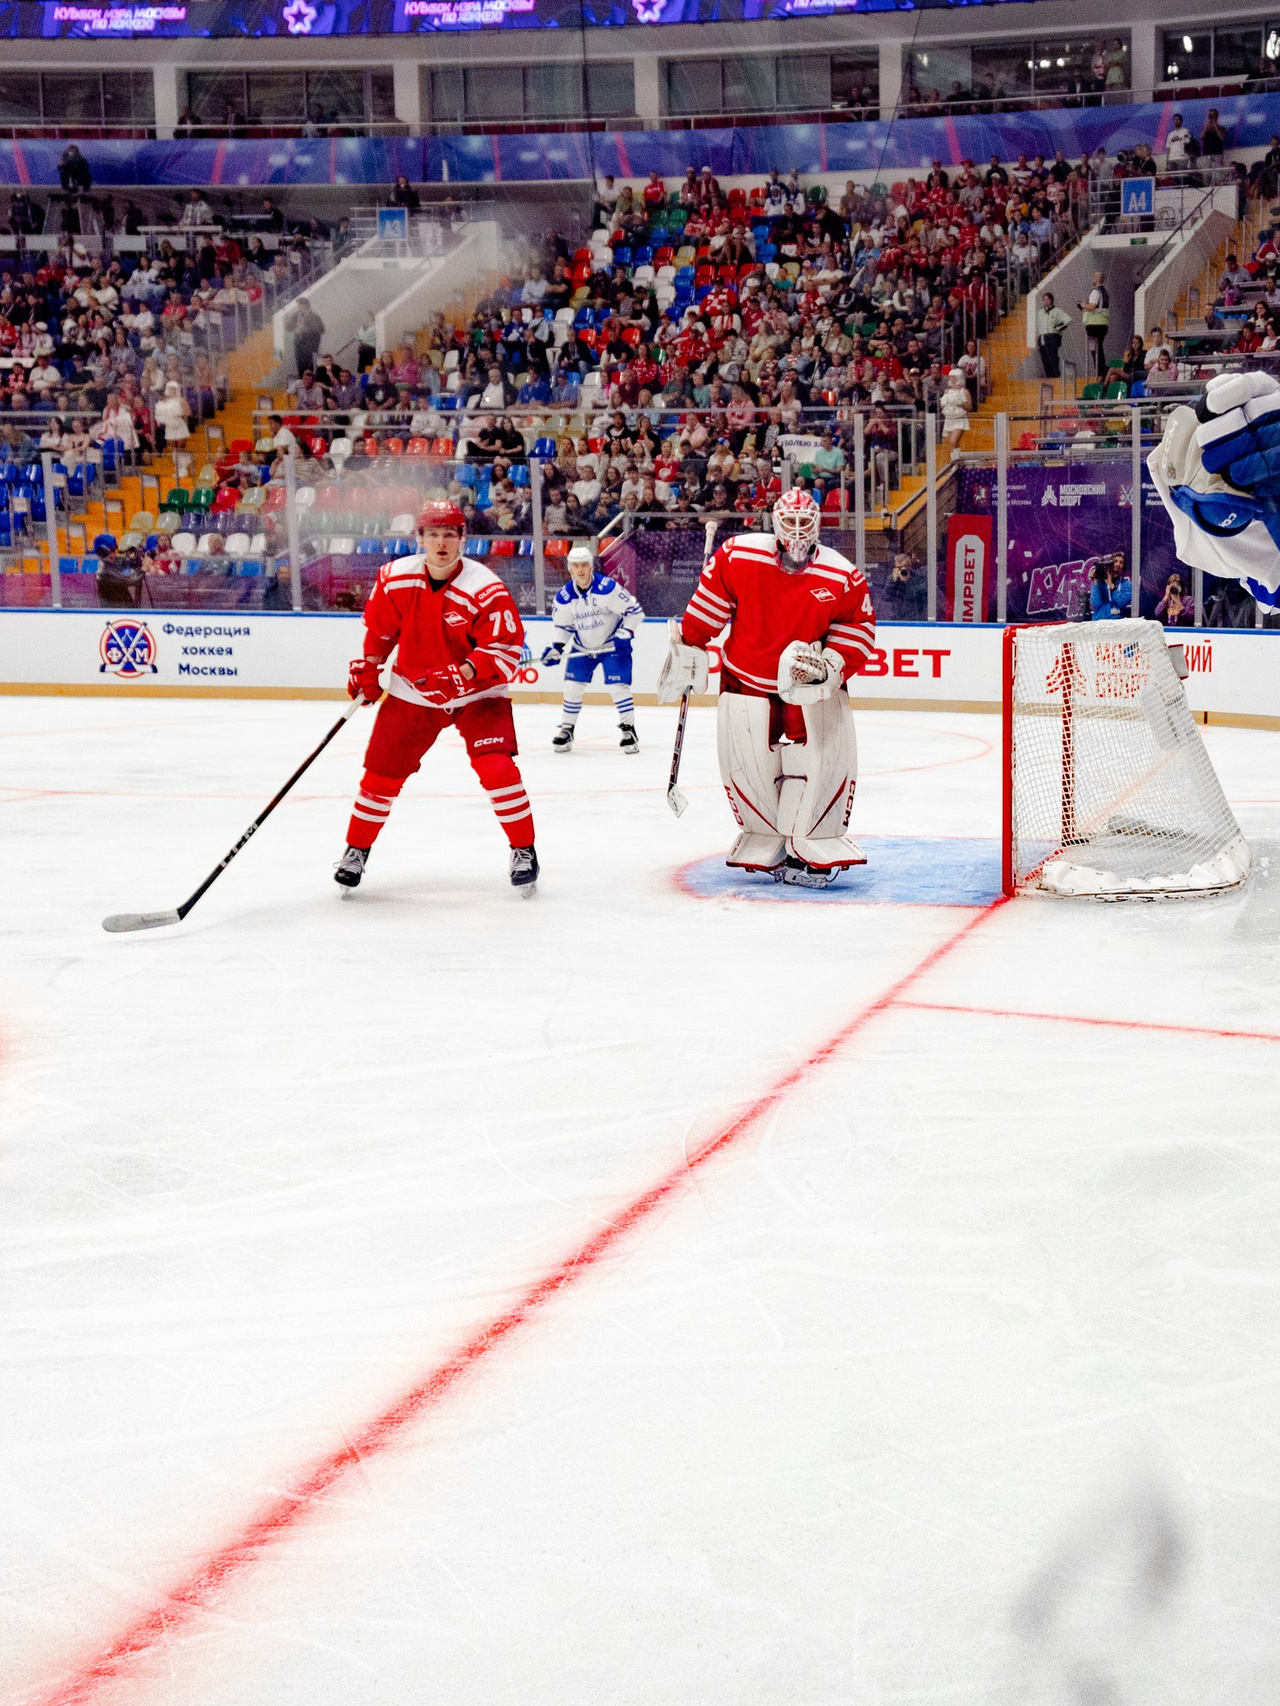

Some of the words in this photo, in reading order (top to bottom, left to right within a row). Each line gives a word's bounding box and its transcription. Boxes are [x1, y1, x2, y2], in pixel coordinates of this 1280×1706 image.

[1060, 481, 1106, 495] МОСКОВСКИЙ
[1060, 495, 1081, 507] СПОРТ
[962, 544, 977, 622] IMPBET
[162, 622, 251, 638] Федерация
[489, 609, 517, 637] 78
[181, 645, 234, 656] хоккея
[177, 663, 238, 676] Москвы
[473, 736, 504, 749] CCM
[842, 779, 856, 828] CCM
